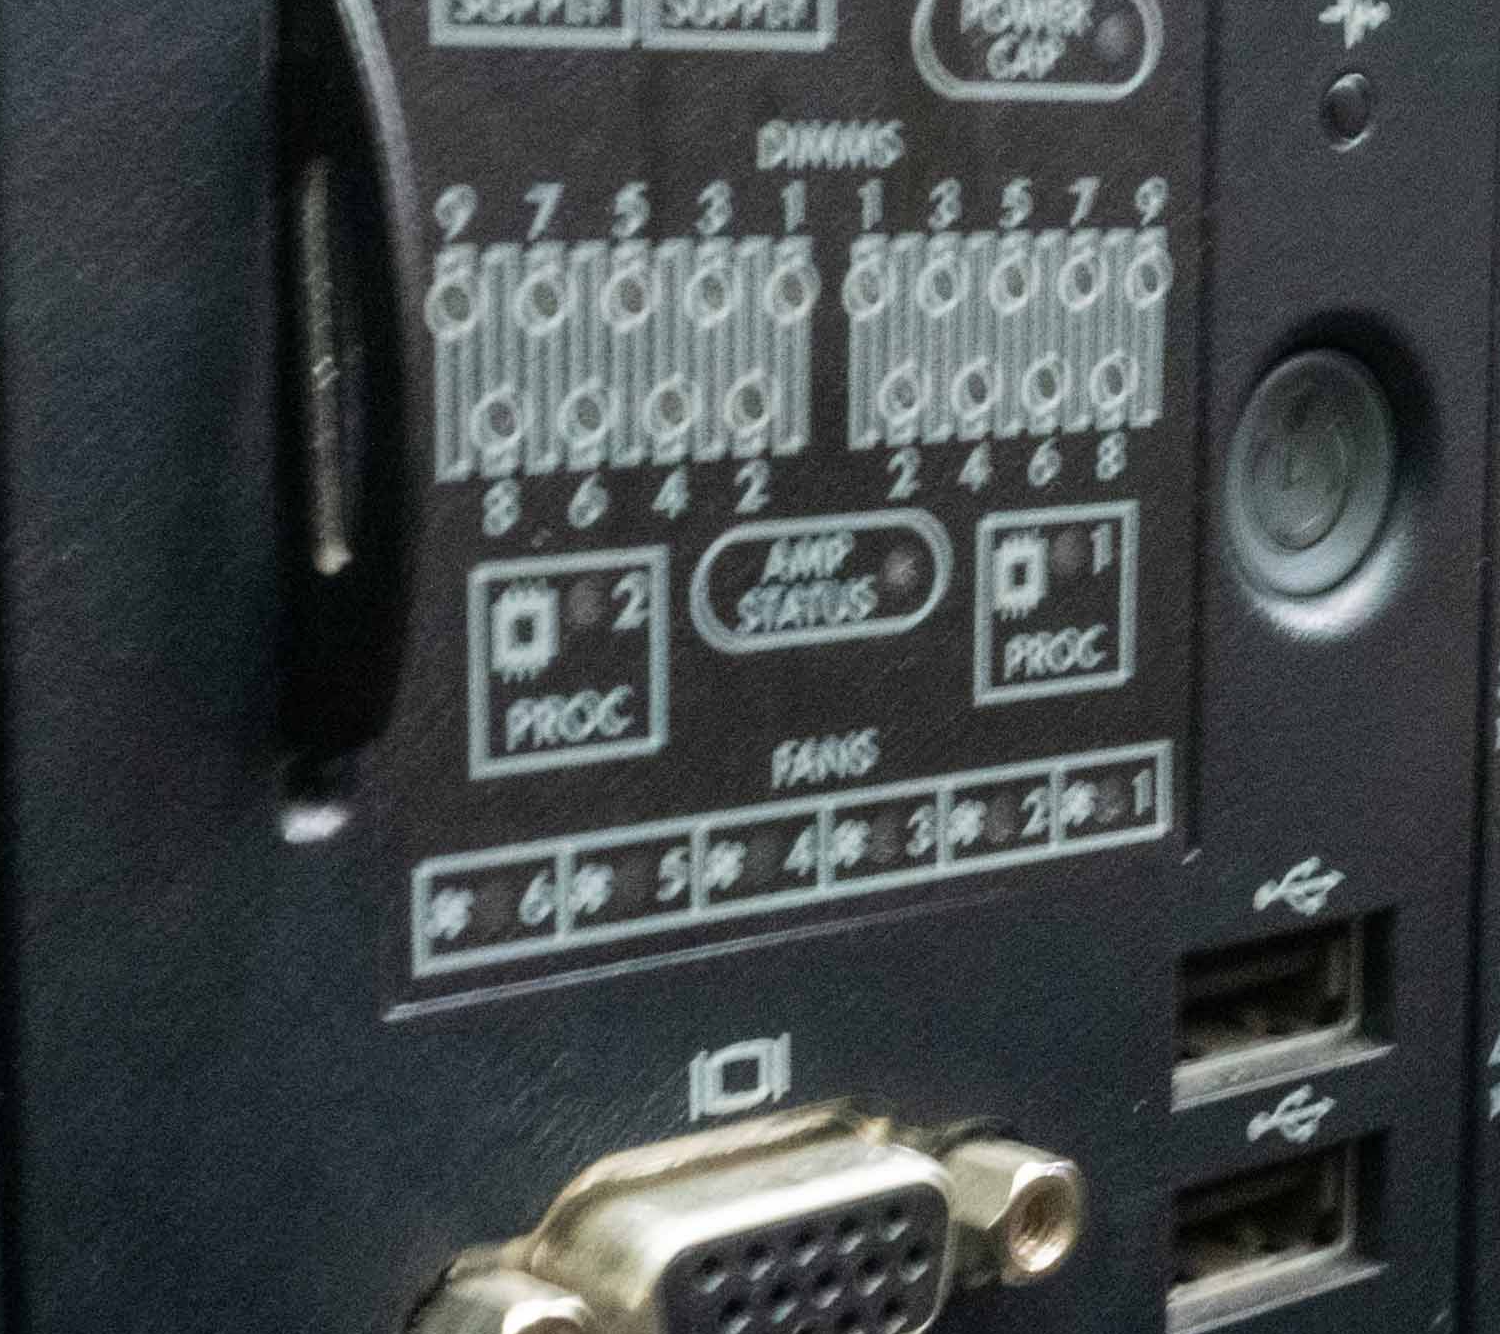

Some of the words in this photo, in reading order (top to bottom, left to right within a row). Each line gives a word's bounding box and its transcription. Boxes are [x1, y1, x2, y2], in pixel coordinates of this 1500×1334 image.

[987, 33, 1067, 80] CAP
[757, 120, 905, 170] DIMMS
[435, 183, 478, 239] 9
[523, 183, 566, 236] 7
[612, 182, 650, 236] 5
[697, 180, 734, 234] 3
[782, 179, 806, 230] 1
[860, 180, 884, 229] 1
[929, 178, 962, 230] 3
[999, 178, 1033, 229] 5
[1067, 177, 1100, 227] 7
[1134, 176, 1170, 226] 9
[886, 447, 923, 501] 2
[958, 440, 994, 494] 4
[1027, 433, 1062, 486] 6
[1095, 428, 1127, 481] 8
[482, 479, 522, 537] 8
[568, 475, 609, 529] 6
[653, 468, 689, 520] 4
[734, 460, 772, 514] 2
[762, 532, 856, 582] AMP
[1089, 524, 1114, 576] 1
[611, 576, 650, 633] 2
[734, 576, 878, 633] STATUS
[1003, 625, 1109, 680] PROC
[505, 684, 636, 750] PROC
[770, 727, 880, 789] FANS
[519, 875, 555, 929] 6
[655, 848, 692, 903] 5
[783, 824, 819, 876] 4
[905, 805, 937, 860] 3
[1019, 785, 1050, 839] 2
[1128, 770, 1154, 815] 1
